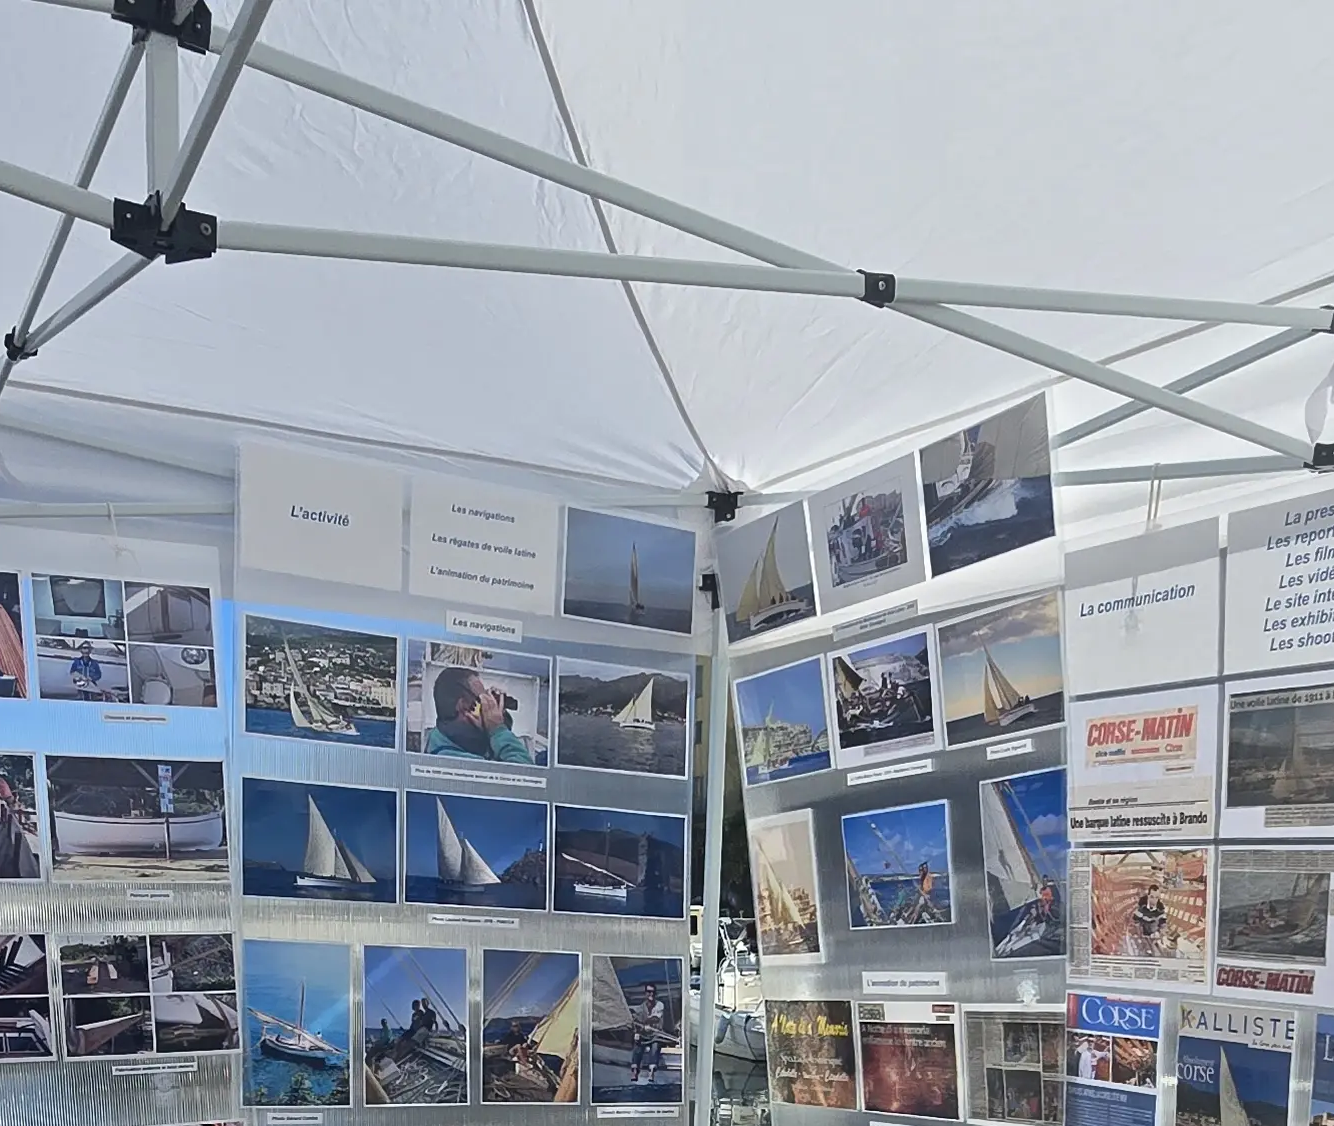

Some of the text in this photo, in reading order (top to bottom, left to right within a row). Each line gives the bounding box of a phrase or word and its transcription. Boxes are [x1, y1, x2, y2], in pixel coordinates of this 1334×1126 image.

[291, 505, 350, 526] L'activité
[451, 504, 515, 523] Les navigations
[1285, 511, 1302, 526] La
[431, 533, 447, 543] Les
[449, 536, 480, 550] régates
[493, 545, 513, 554] voile
[514, 547, 536, 558] latine
[1267, 534, 1291, 550] Les
[1285, 552, 1310, 567] Les
[1279, 573, 1303, 589] Les
[1080, 584, 1195, 617] La communication
[1265, 596, 1281, 612] Le
[1285, 590, 1311, 609] site
[1263, 617, 1287, 632] Les
[1269, 637, 1293, 651] Les
[1087, 708, 1195, 746] CORSE-MATIN
[1070, 817, 1084, 830] Une
[1110, 811, 1131, 828] latine
[1180, 811, 1208, 824] Brando
[1181, 1008, 1295, 1040] KALLISTE
[1177, 1063, 1215, 1083] corse
